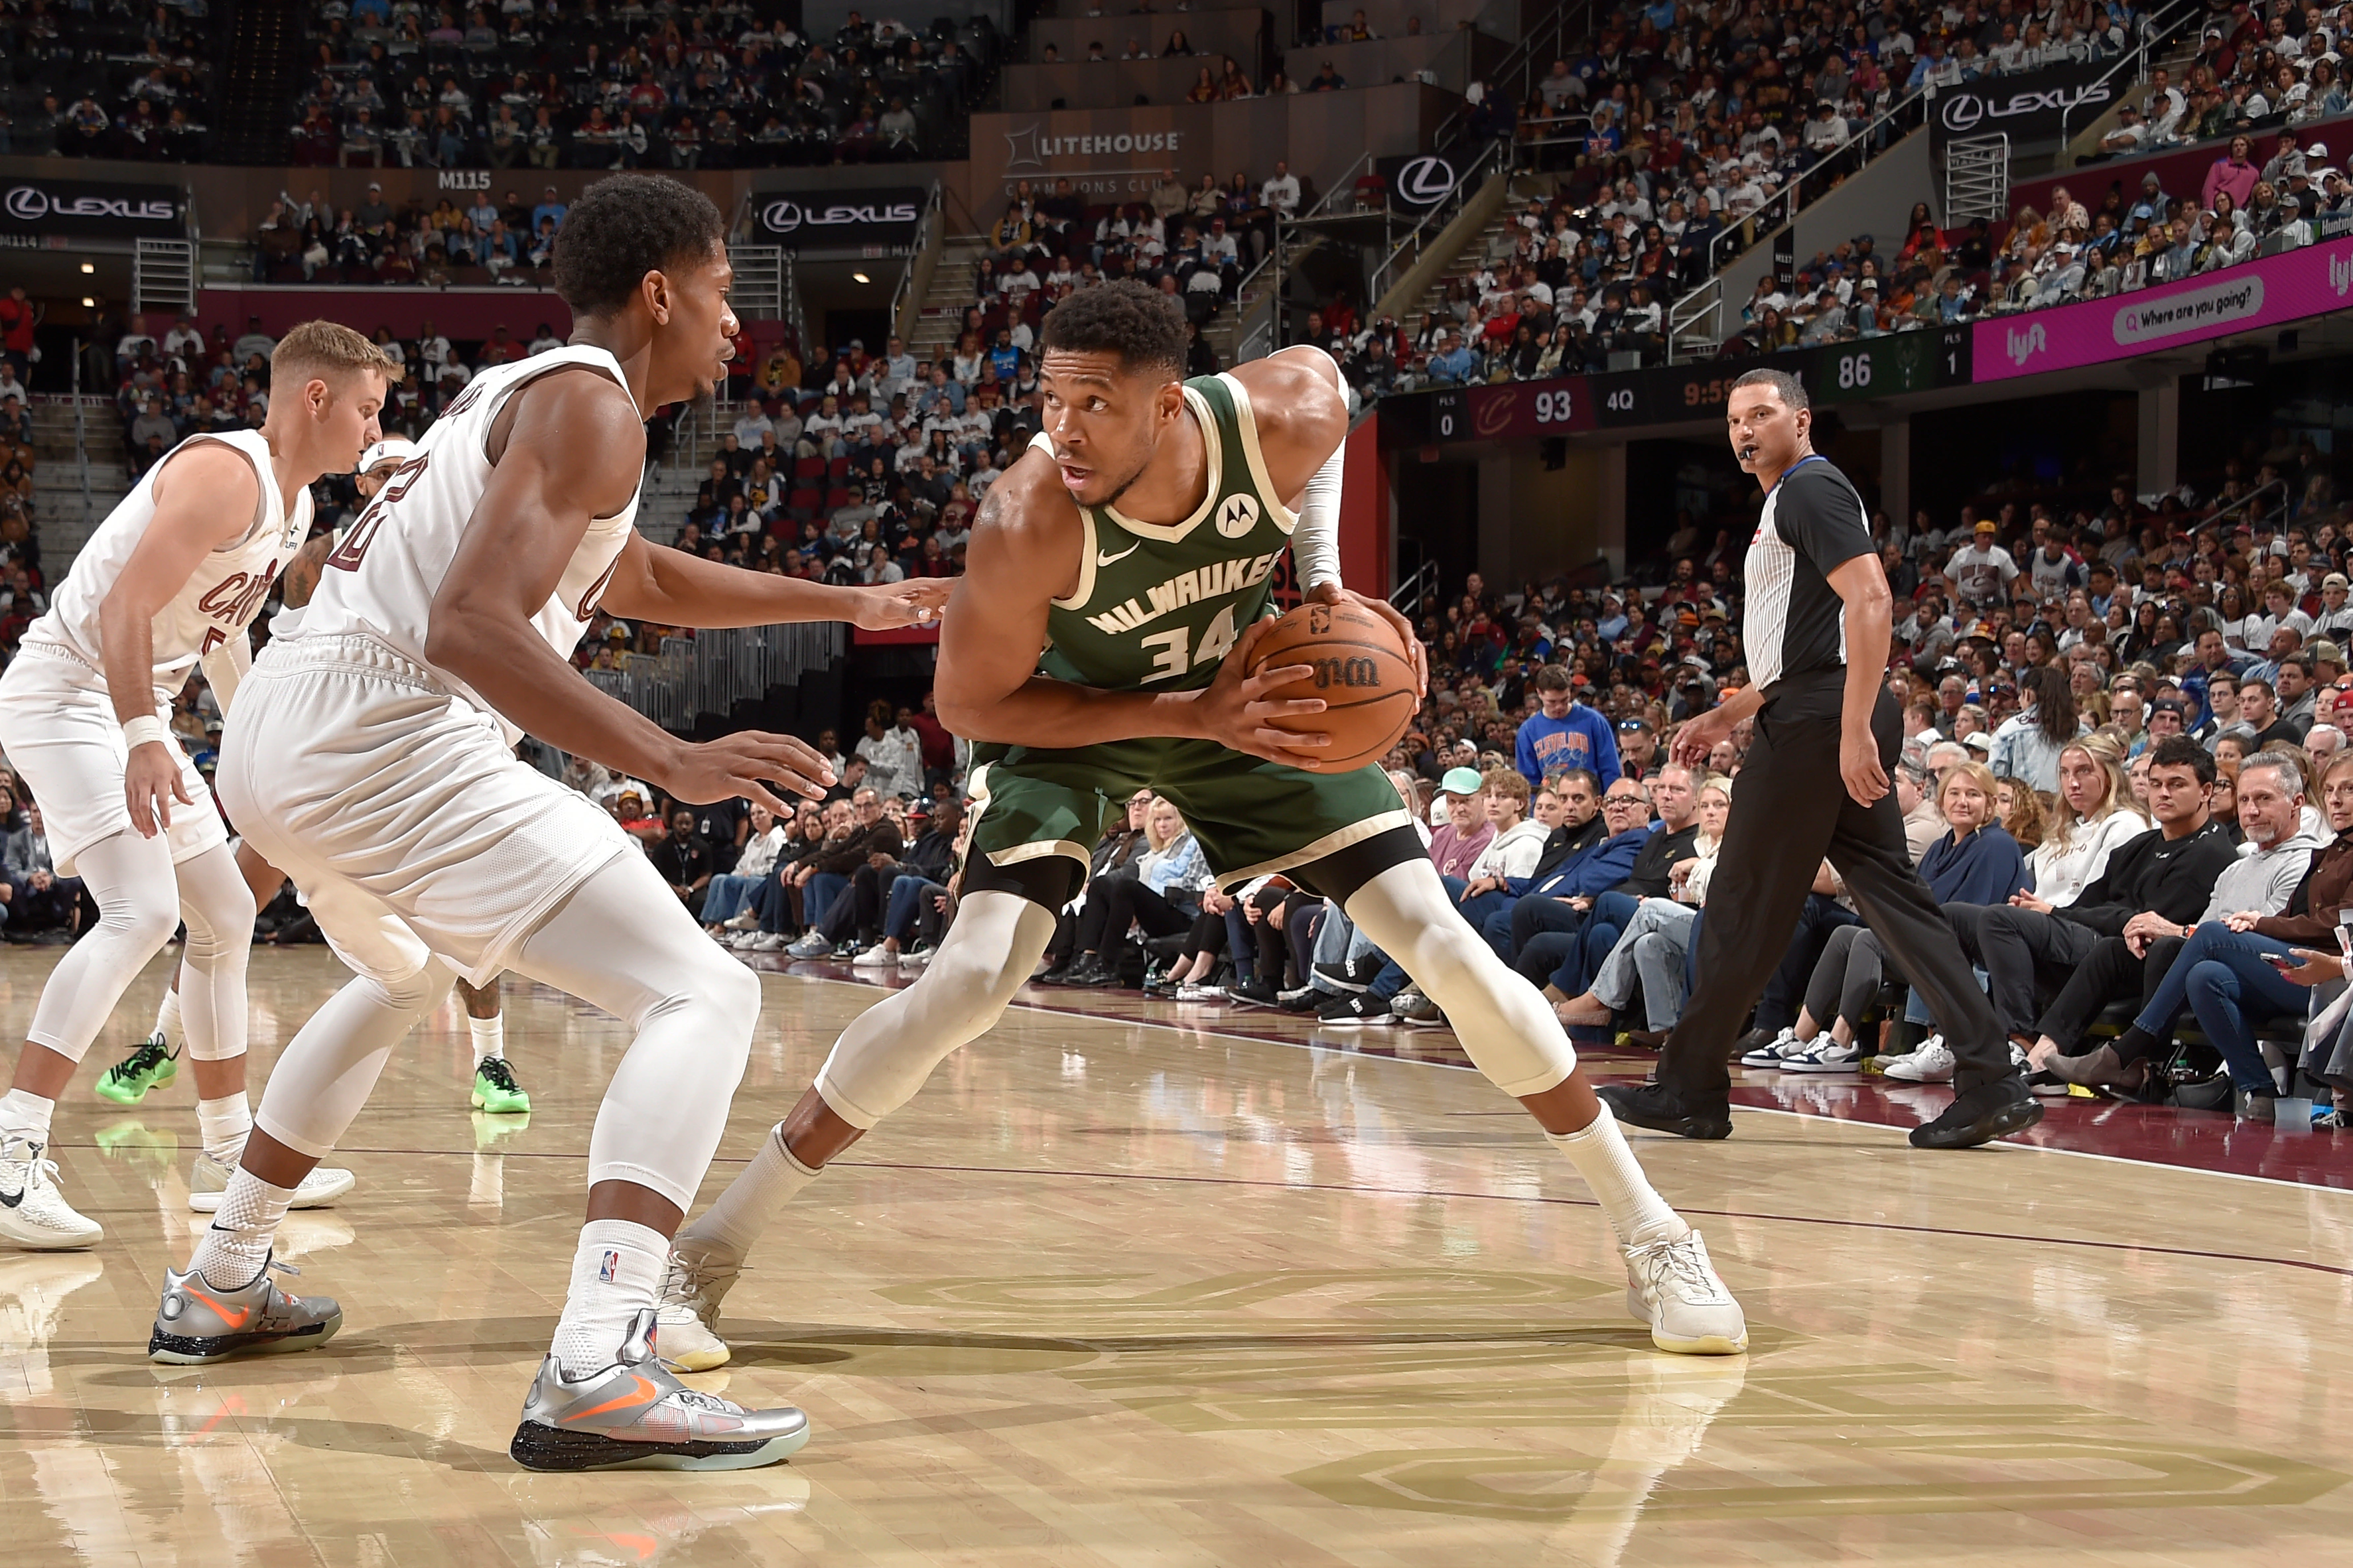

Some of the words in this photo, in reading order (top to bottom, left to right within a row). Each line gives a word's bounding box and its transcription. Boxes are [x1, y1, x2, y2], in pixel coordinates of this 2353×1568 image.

[1988, 82, 2110, 117] LEXUS
[1041, 133, 1178, 156] LITEHOUSE
[439, 171, 491, 190] M115
[1005, 180, 1117, 197] CAMIONS
[1128, 178, 1163, 193] CLU
[52, 196, 174, 220] LEXUS
[805, 204, 917, 225] LEXUS
[2322, 217, 2353, 235] Huntin
[2329, 252, 2353, 296] ly
[2141, 310, 2173, 328] Where
[2177, 304, 2193, 320] are
[2195, 301, 2214, 318] you
[2217, 286, 2252, 314] going?
[1945, 333, 1961, 344] FLS
[2007, 322, 2046, 366] lyft
[1839, 353, 1871, 389] 86
[1948, 353, 1956, 375] 1
[1439, 397, 1455, 407] FLS
[1536, 391, 1572, 423] 93
[1607, 389, 1634, 411] 4Q
[1441, 415, 1453, 436] 0
[1140, 602, 1239, 685] 34
[1308, 655, 1381, 690] Wil
[1534, 732, 1589, 761] CLEVELAND
